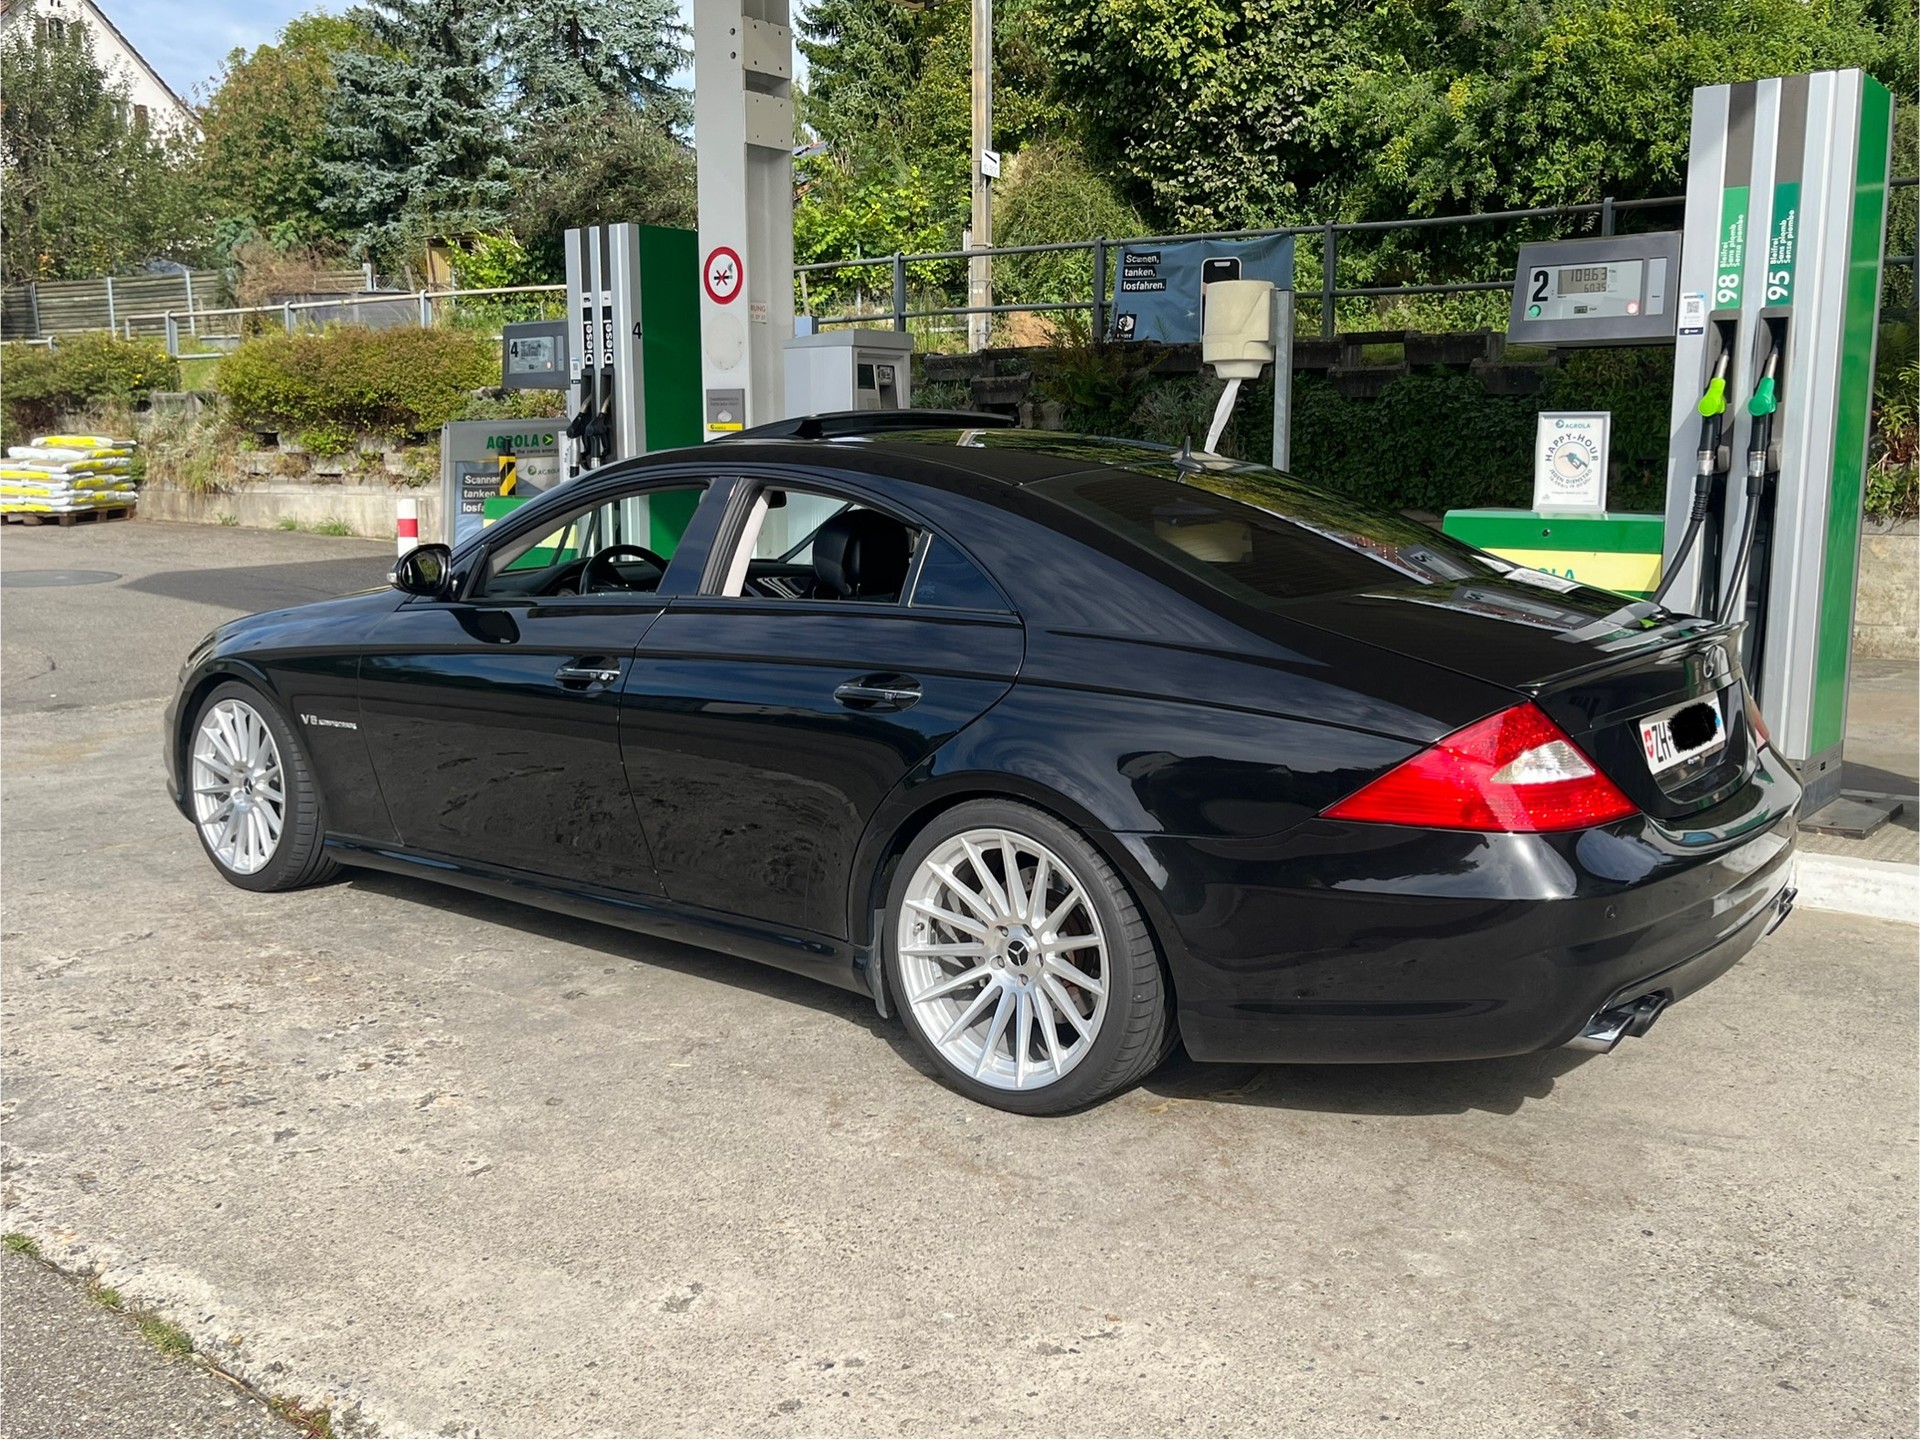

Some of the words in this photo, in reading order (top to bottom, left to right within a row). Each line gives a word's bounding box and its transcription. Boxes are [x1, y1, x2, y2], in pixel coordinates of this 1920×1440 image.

[1728, 224, 1736, 247] plomb
[1778, 220, 1787, 244] plomb
[1720, 242, 1728, 268] Bleifrei
[1726, 250, 1735, 267] Sans
[1734, 245, 1742, 267] Senza
[1770, 238, 1778, 264] Bleifrei
[1776, 246, 1785, 264] Sans
[1783, 241, 1792, 263] Senza
[1125, 268, 1155, 277] tanken,
[1123, 281, 1165, 290] losfahren.
[1532, 270, 1549, 302] 2
[1717, 274, 1739, 303] 98
[1767, 271, 1790, 300] 95
[632, 322, 642, 339] 4
[510, 342, 519, 357] 4
[584, 321, 593, 365] Diesel
[603, 320, 613, 364] Diesel
[300, 713, 318, 725] V8
